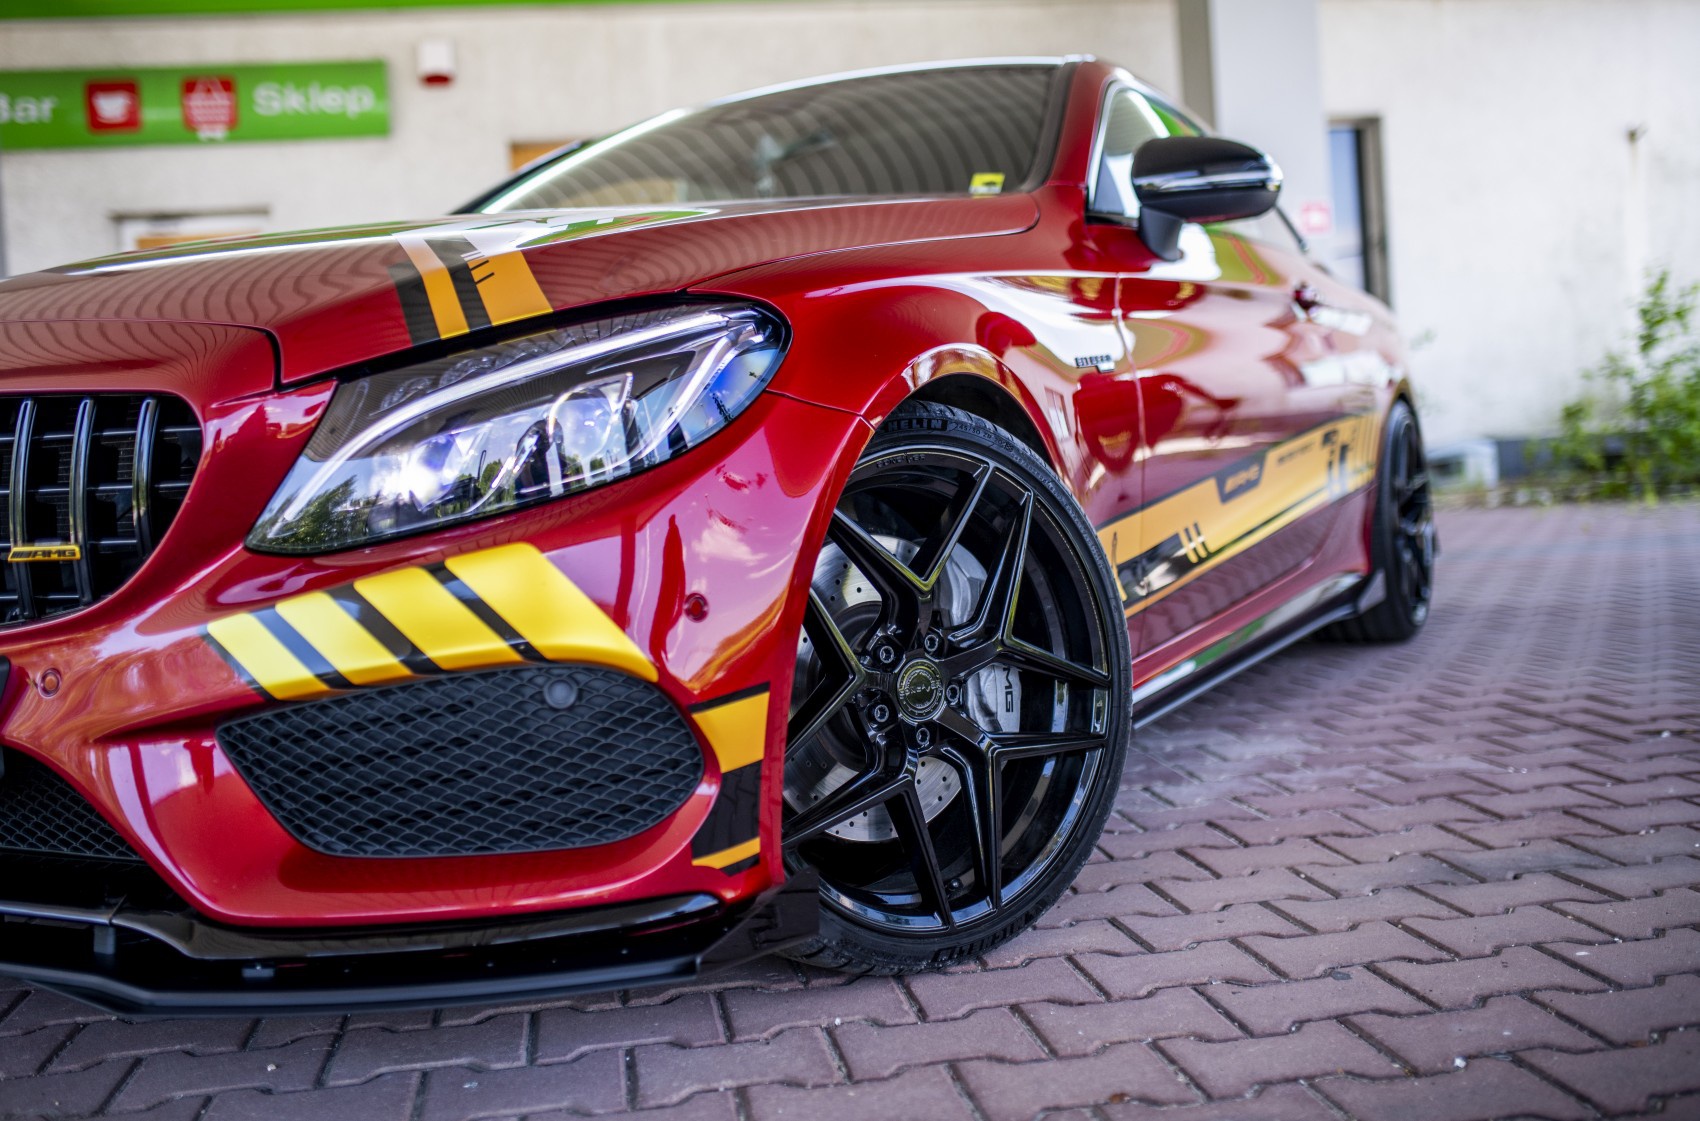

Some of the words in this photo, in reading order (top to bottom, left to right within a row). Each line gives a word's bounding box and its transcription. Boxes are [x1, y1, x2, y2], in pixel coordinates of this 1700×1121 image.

[252, 81, 375, 119] Sklep
[31, 549, 76, 559] AMG
[1002, 663, 1014, 713] MG
